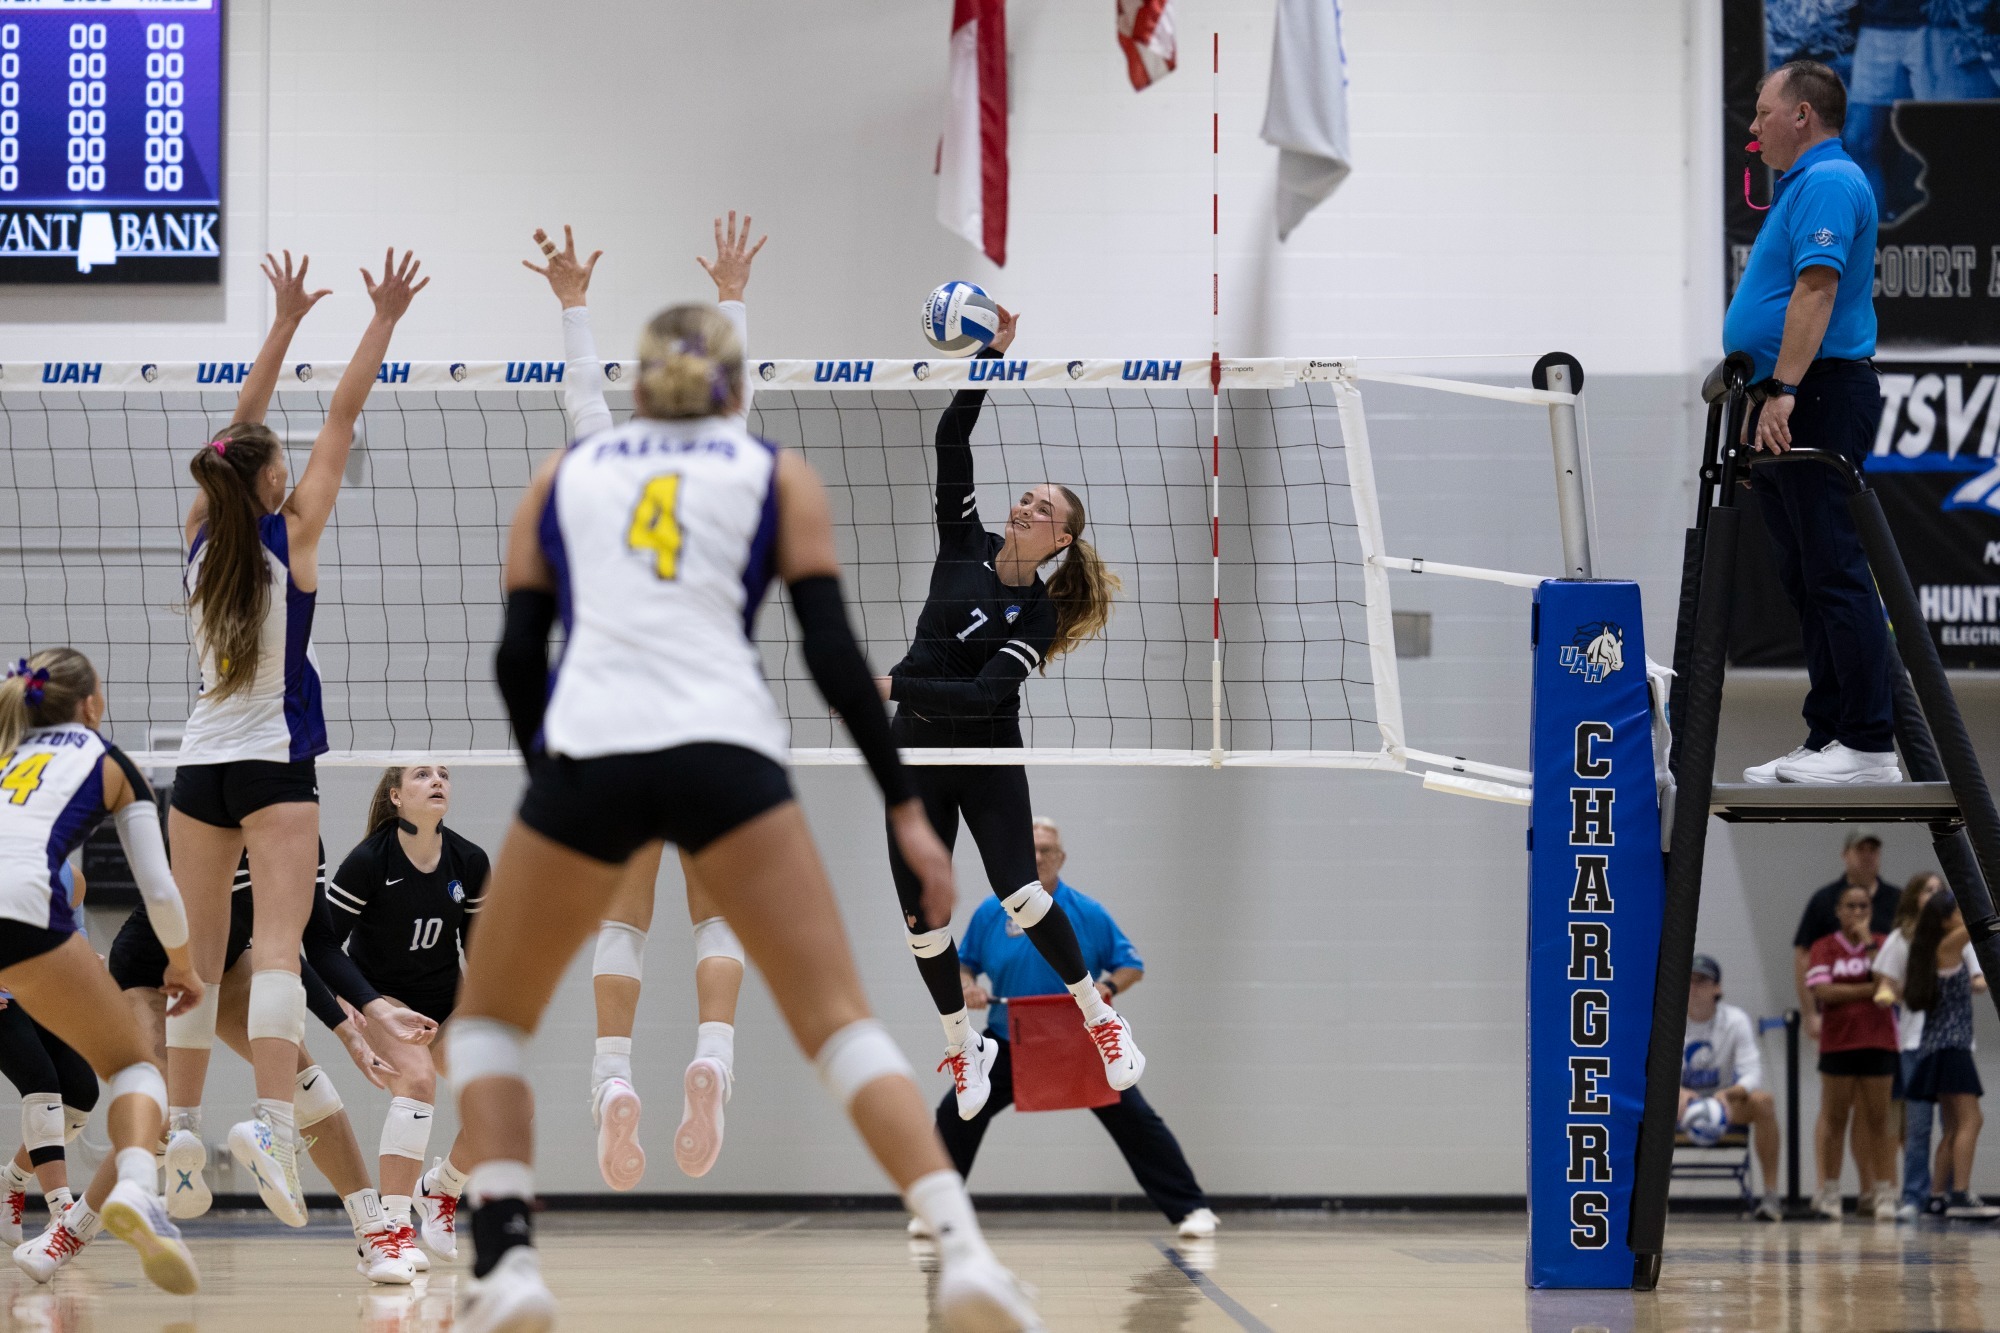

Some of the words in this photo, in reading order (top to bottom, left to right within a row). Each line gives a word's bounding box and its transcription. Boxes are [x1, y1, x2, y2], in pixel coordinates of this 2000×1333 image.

[70, 24, 106, 50] 00
[147, 24, 183, 50] 00
[70, 53, 106, 78] 00
[147, 53, 183, 78] 00
[69, 81, 106, 108] 00
[146, 81, 183, 108] 00
[68, 110, 106, 136] 00
[146, 110, 183, 136] 00
[68, 137, 106, 164] 00
[145, 137, 183, 164] 00
[68, 164, 106, 192] 00
[145, 164, 183, 192] 00
[118, 212, 219, 251] BANK
[933, 291, 951, 326] NCAA
[42, 362, 102, 384] UAH
[196, 362, 255, 384] UAH
[375, 362, 411, 384] AH
[505, 361, 566, 383] UAH
[813, 361, 874, 383] UAH
[968, 360, 1028, 382] UAH
[1121, 360, 1183, 381] UAH
[1317, 361, 1342, 369] Senoh
[1873, 373, 2000, 461] TSVI
[627, 472, 683, 581] 4
[1920, 585, 2000, 622] HUNT
[956, 607, 989, 643] 7
[1559, 646, 1605, 684] UAH
[409, 917, 443, 951] 10
[1566, 720, 1615, 1250] CHARGERS
